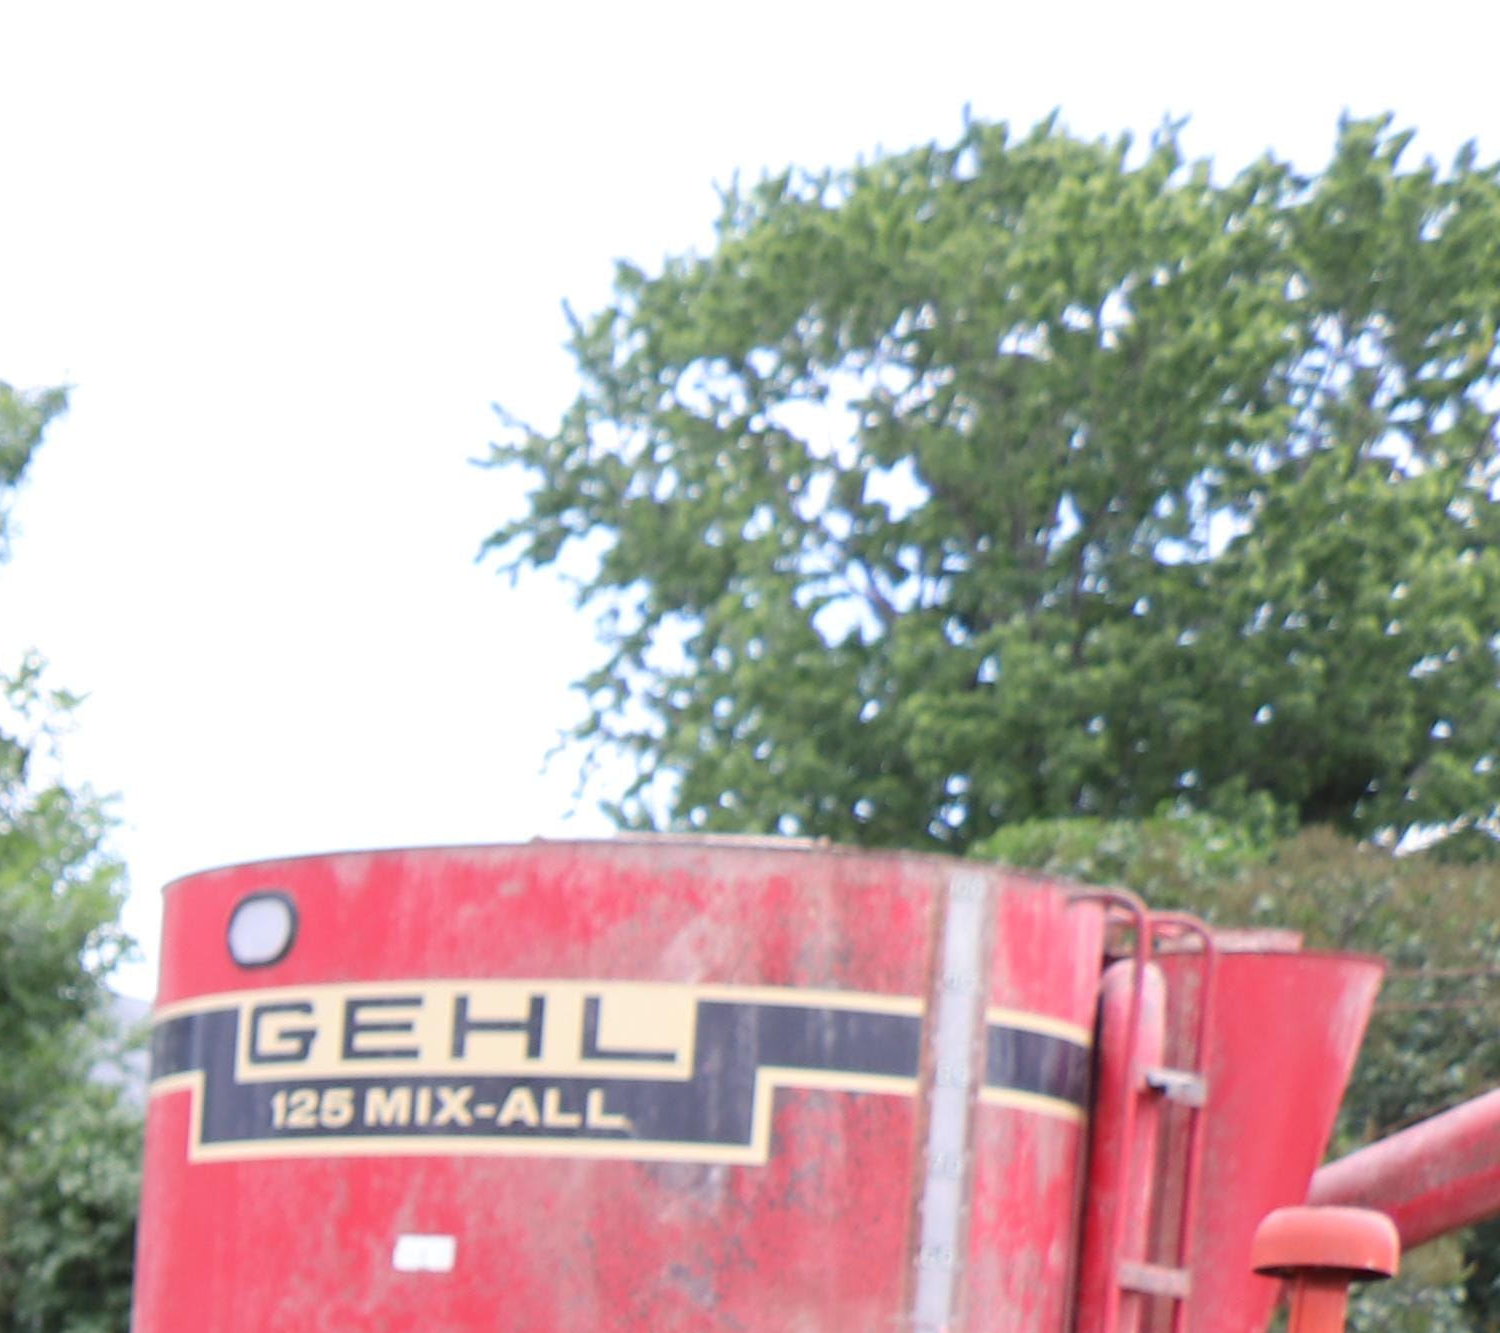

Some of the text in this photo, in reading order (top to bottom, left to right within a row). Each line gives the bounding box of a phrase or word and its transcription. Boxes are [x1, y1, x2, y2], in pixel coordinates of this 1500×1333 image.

[249, 994, 677, 1065] GEHL
[271, 1086, 634, 1130] 125 MIX-ALL
